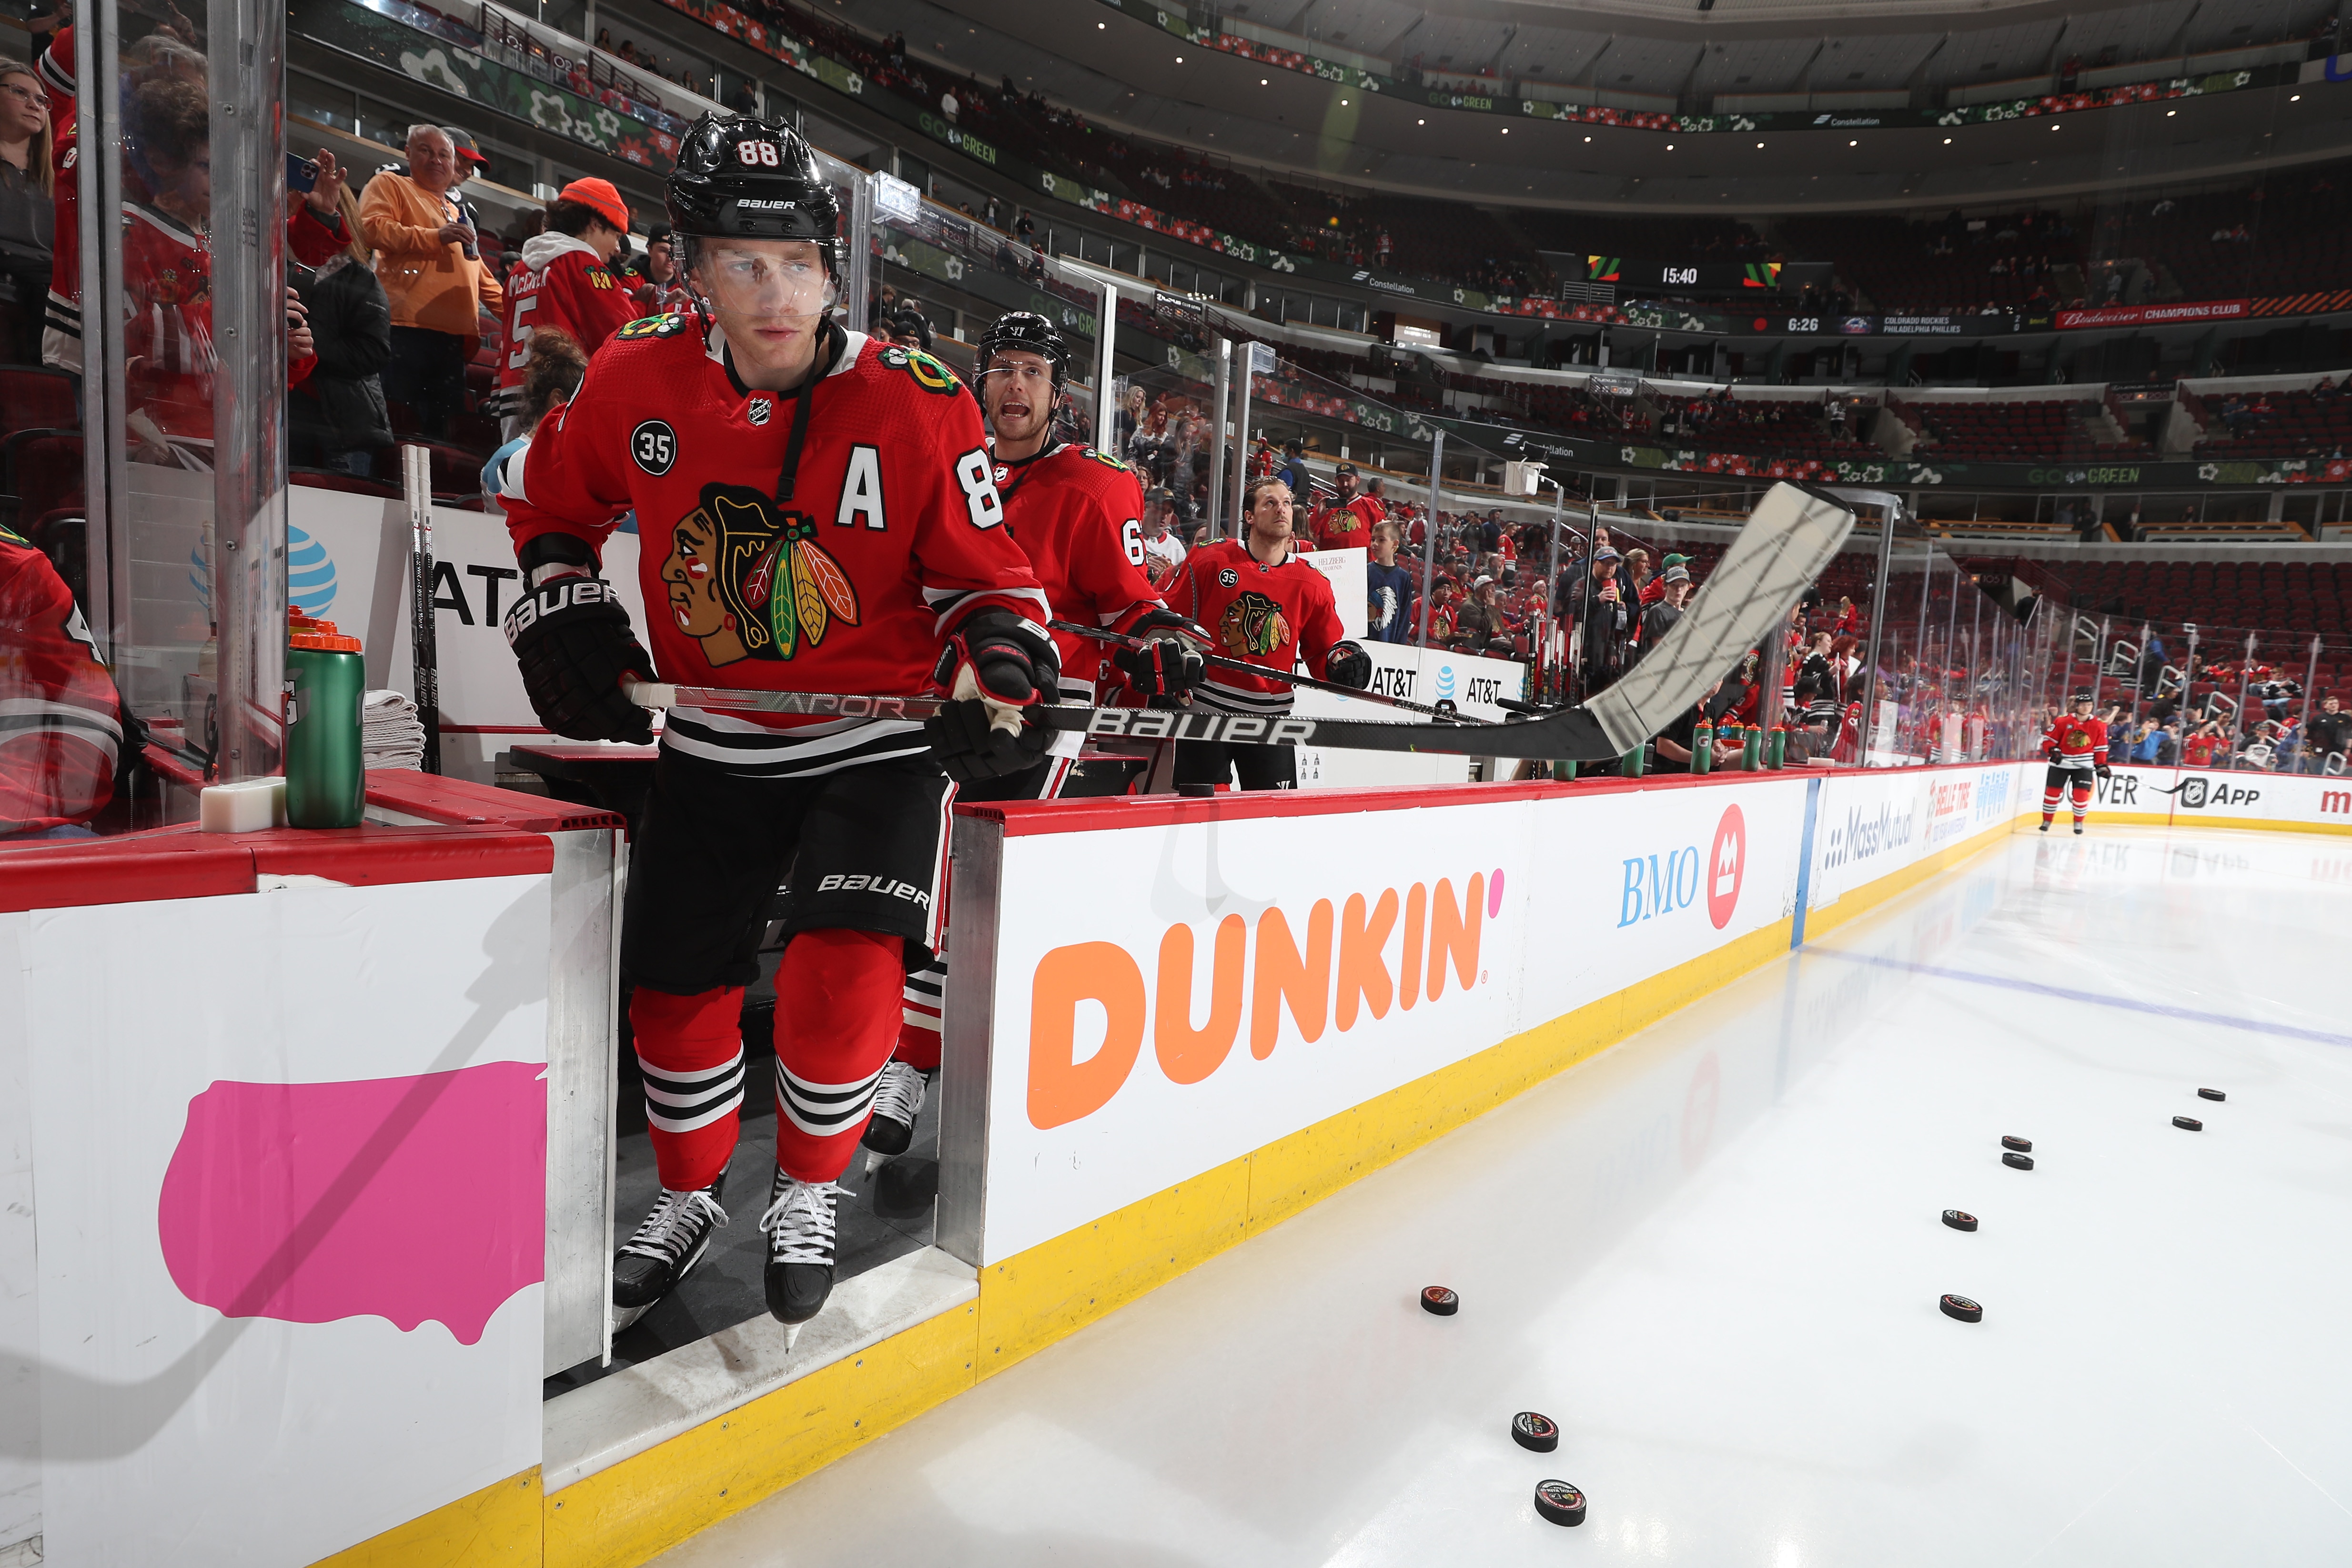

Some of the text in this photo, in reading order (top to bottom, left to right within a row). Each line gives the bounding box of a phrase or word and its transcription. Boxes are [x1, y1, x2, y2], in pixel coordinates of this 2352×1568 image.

[1429, 92, 1491, 110] GO GREEN
[1831, 118, 1879, 126] Constellation
[737, 140, 779, 167] 88
[919, 112, 995, 164] GO GREEN
[737, 199, 796, 209] BAUER
[1369, 277, 1414, 294] Constellation
[1663, 267, 1697, 284] 15:40
[1788, 318, 1818, 331] 6:26
[2062, 312, 2138, 325] Budweiser
[2145, 306, 2210, 319] CHAMPIONS
[2212, 304, 2240, 315] CLUB
[508, 295, 537, 369] 5
[639, 432, 671, 464] 35
[837, 446, 884, 529] A
[2028, 467, 2139, 484] GO GREEN
[1318, 556, 1346, 566] HELZBERG
[1222, 572, 1236, 584] 35
[505, 582, 623, 647] BAUER
[419, 667, 428, 707] BAUER
[430, 668, 438, 708] BAUER
[1371, 666, 1417, 697] AT&T
[1466, 677, 1501, 704] AT&T
[1087, 709, 1317, 746] BAUER
[1935, 781, 1971, 817] BELLE TIRE
[1843, 797, 1917, 864] MassMutual
[817, 874, 930, 910] BAUER
[1617, 846, 1699, 929] BMO
[1026, 867, 1504, 1130] DUNKIN'
